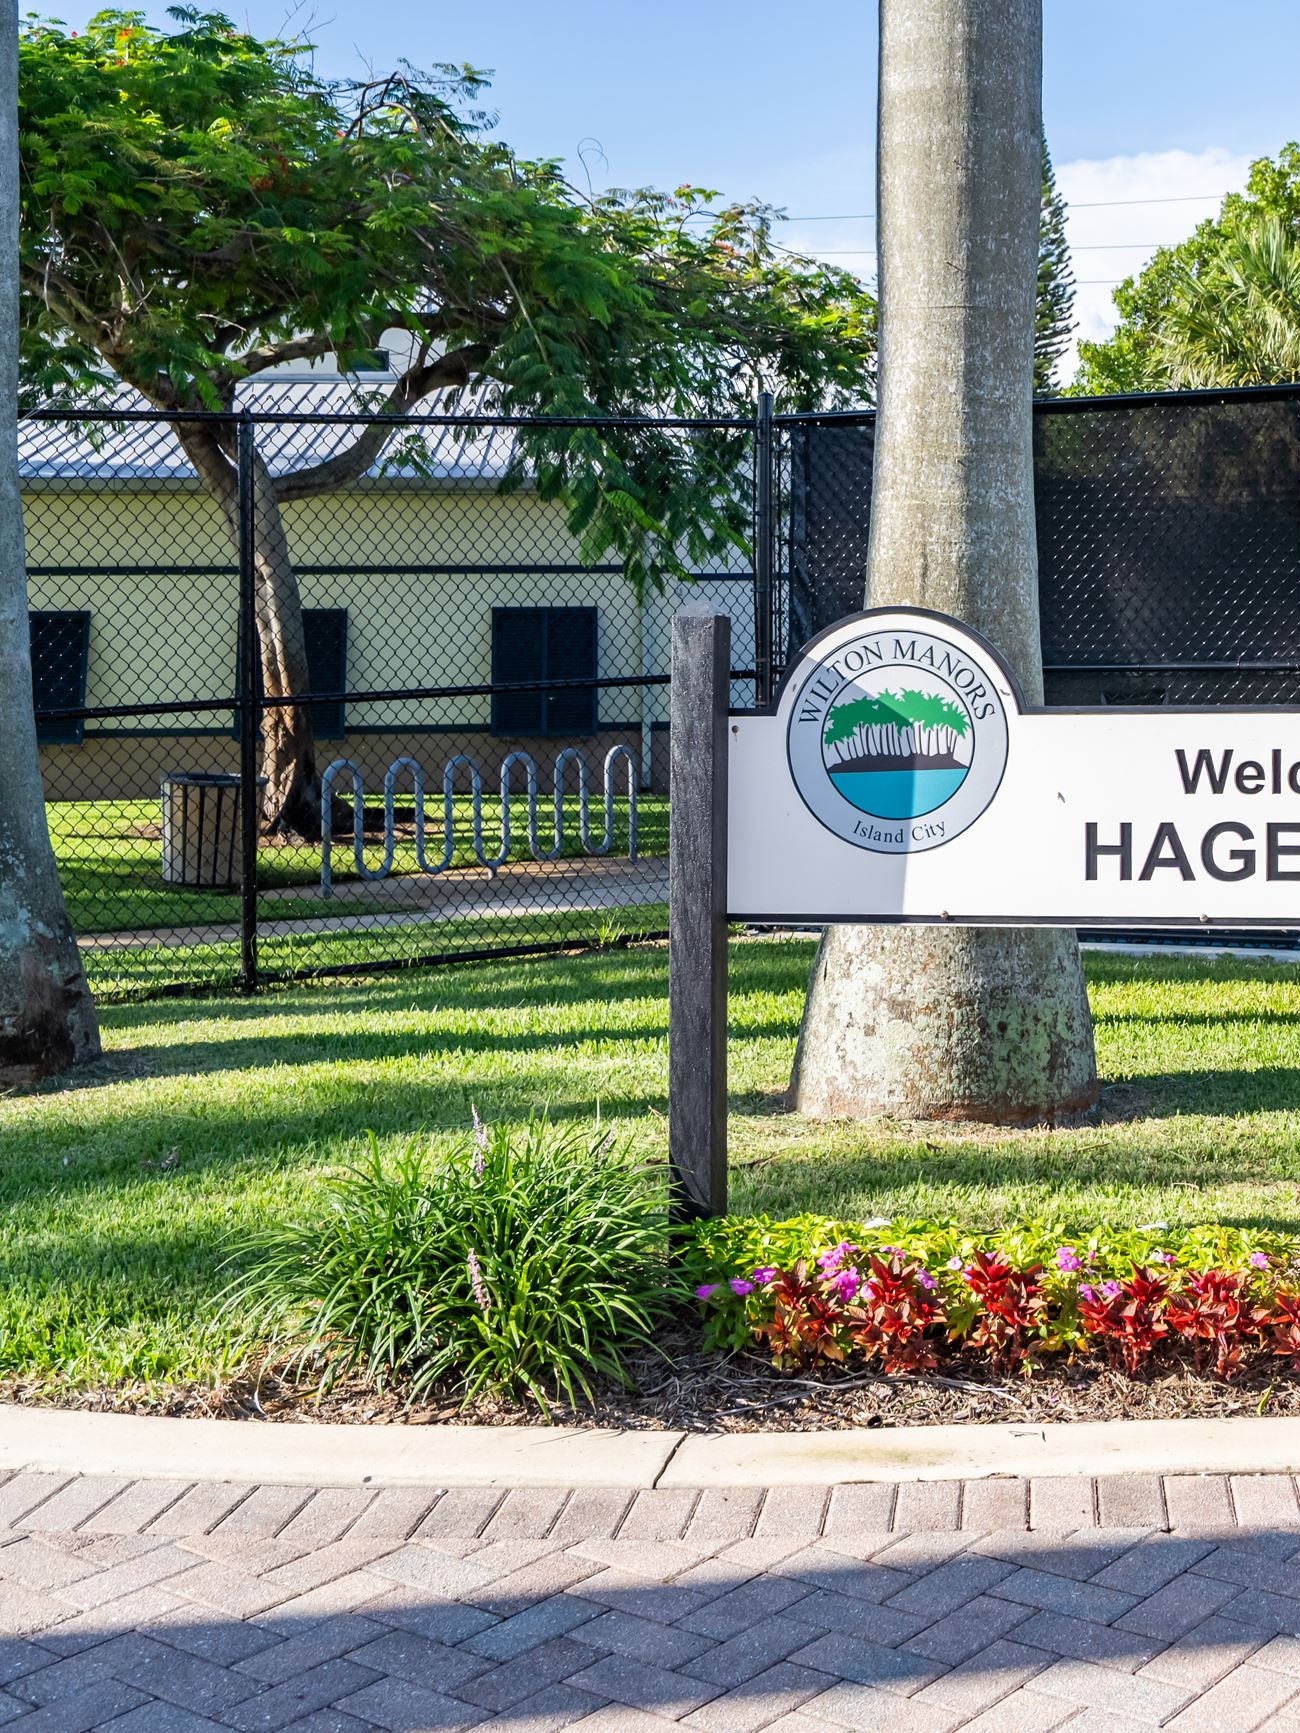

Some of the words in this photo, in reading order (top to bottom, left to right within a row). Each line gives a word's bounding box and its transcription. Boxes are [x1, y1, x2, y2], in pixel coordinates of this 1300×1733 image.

[799, 642, 883, 724] WILTON
[893, 639, 995, 720] MANORS
[853, 820, 904, 843] Island
[912, 821, 946, 842] City
